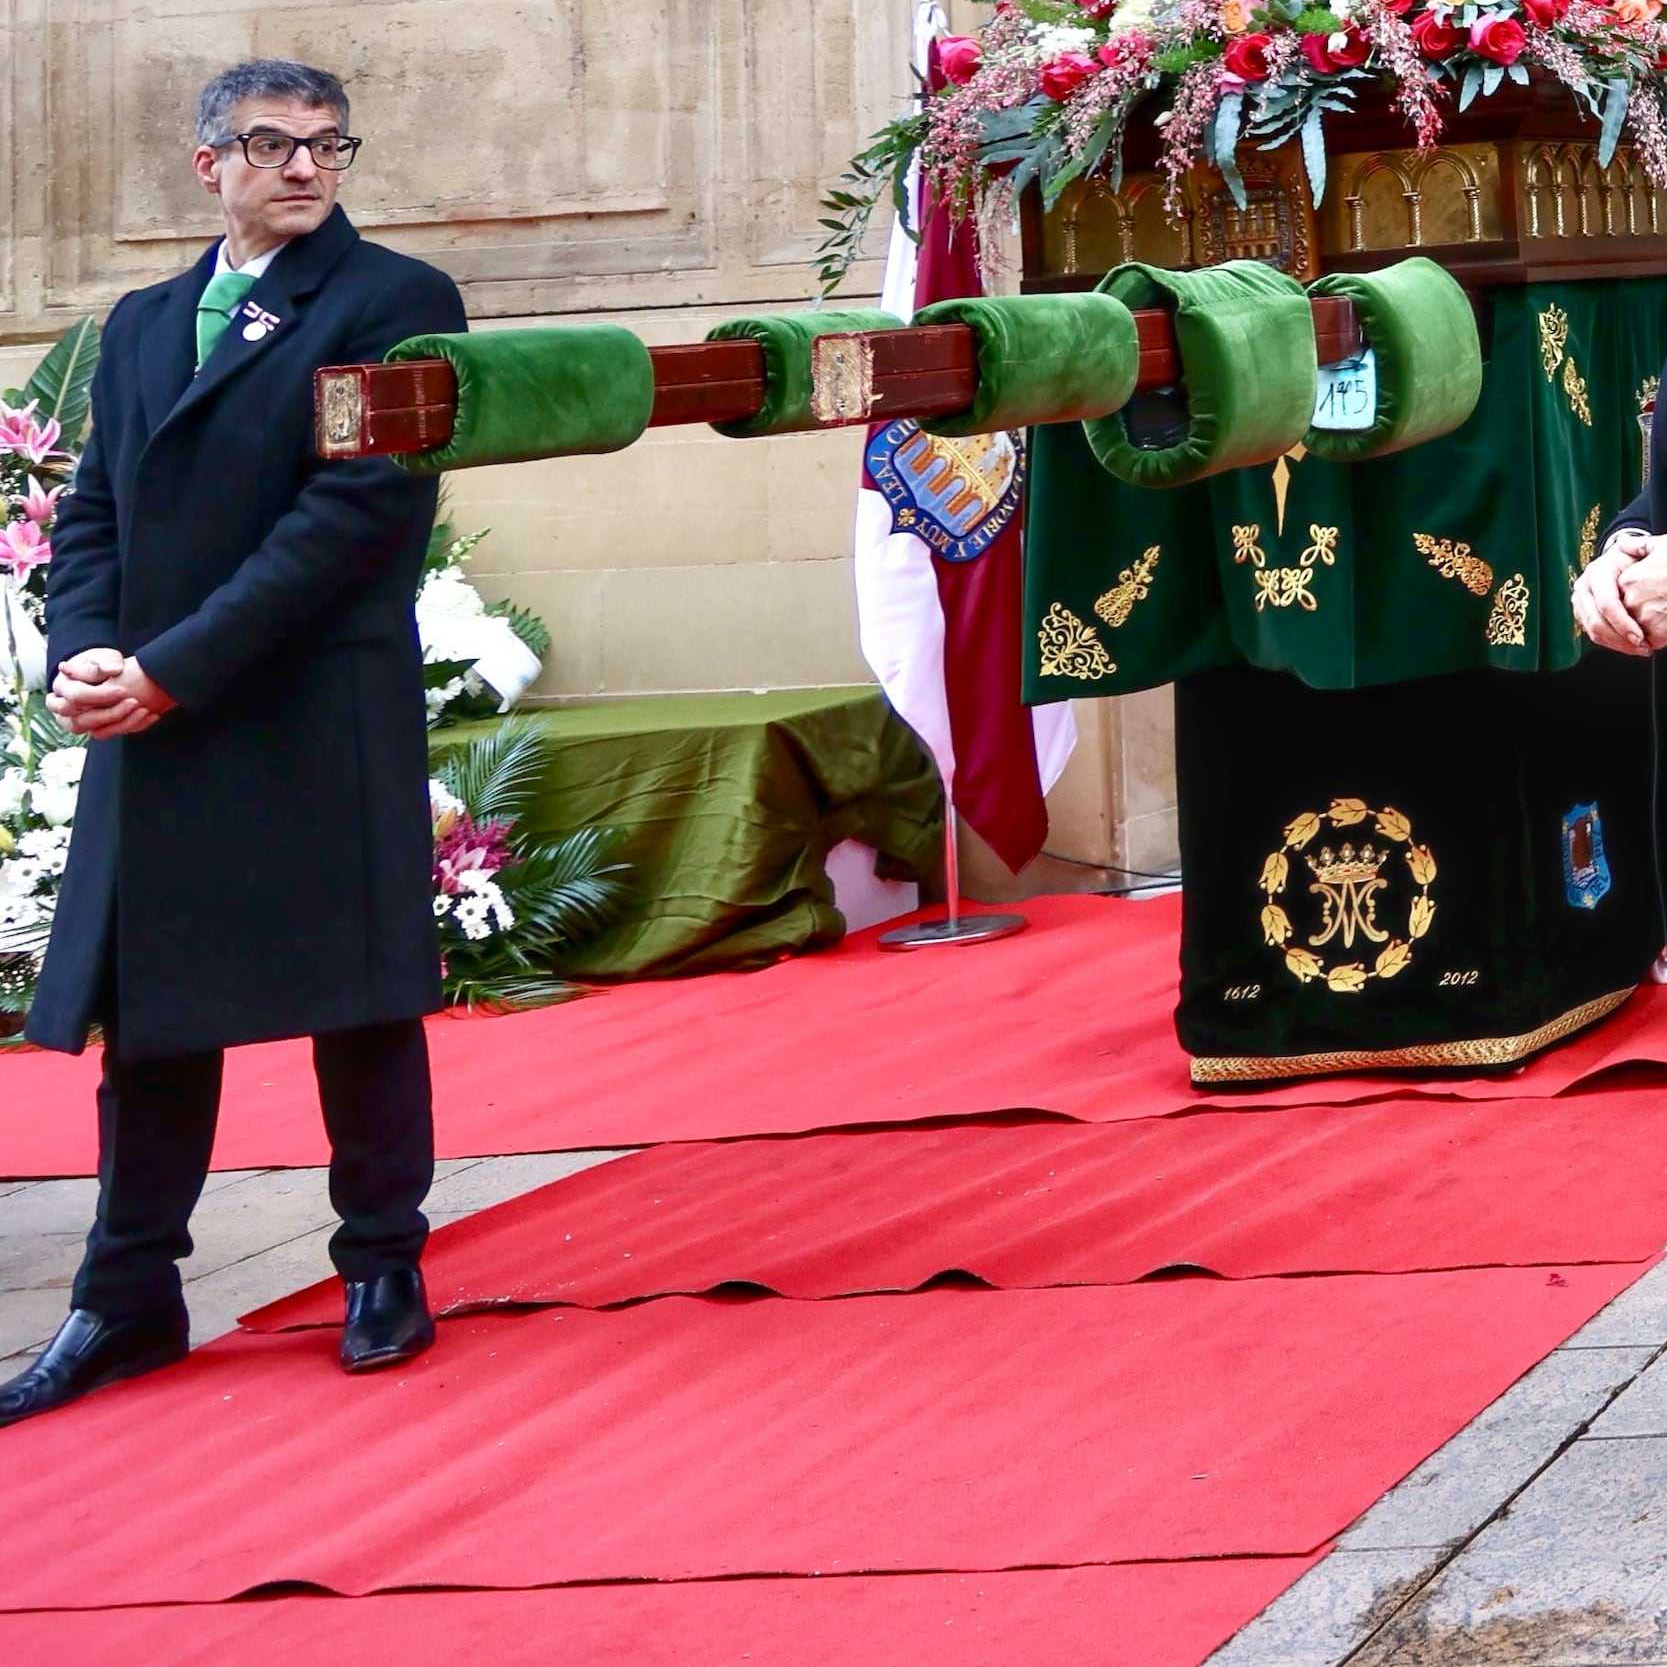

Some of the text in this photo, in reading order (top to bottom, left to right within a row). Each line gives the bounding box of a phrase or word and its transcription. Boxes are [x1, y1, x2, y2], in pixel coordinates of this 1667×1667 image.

[870, 450, 908, 505] LEAL
[915, 517, 956, 553] MUY
[1438, 969, 1480, 987] 2012
[1223, 984, 1262, 1001] 1612
